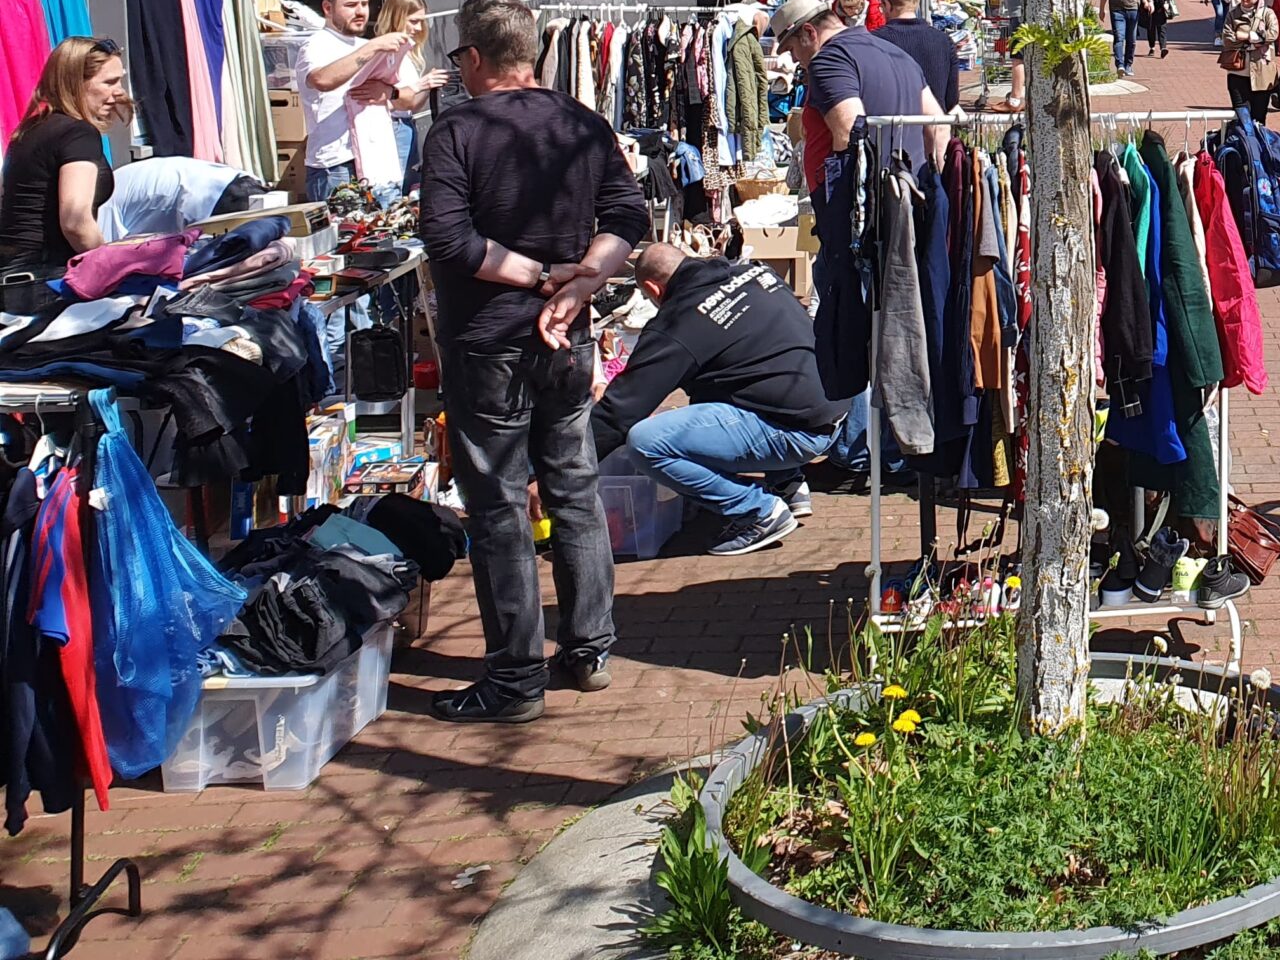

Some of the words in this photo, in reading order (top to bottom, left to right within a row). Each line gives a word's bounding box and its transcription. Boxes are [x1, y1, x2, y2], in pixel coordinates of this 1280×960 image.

[697, 290, 725, 314] new
[709, 298, 731, 318] ATHLETIC
[718, 311, 732, 324] GEAR
